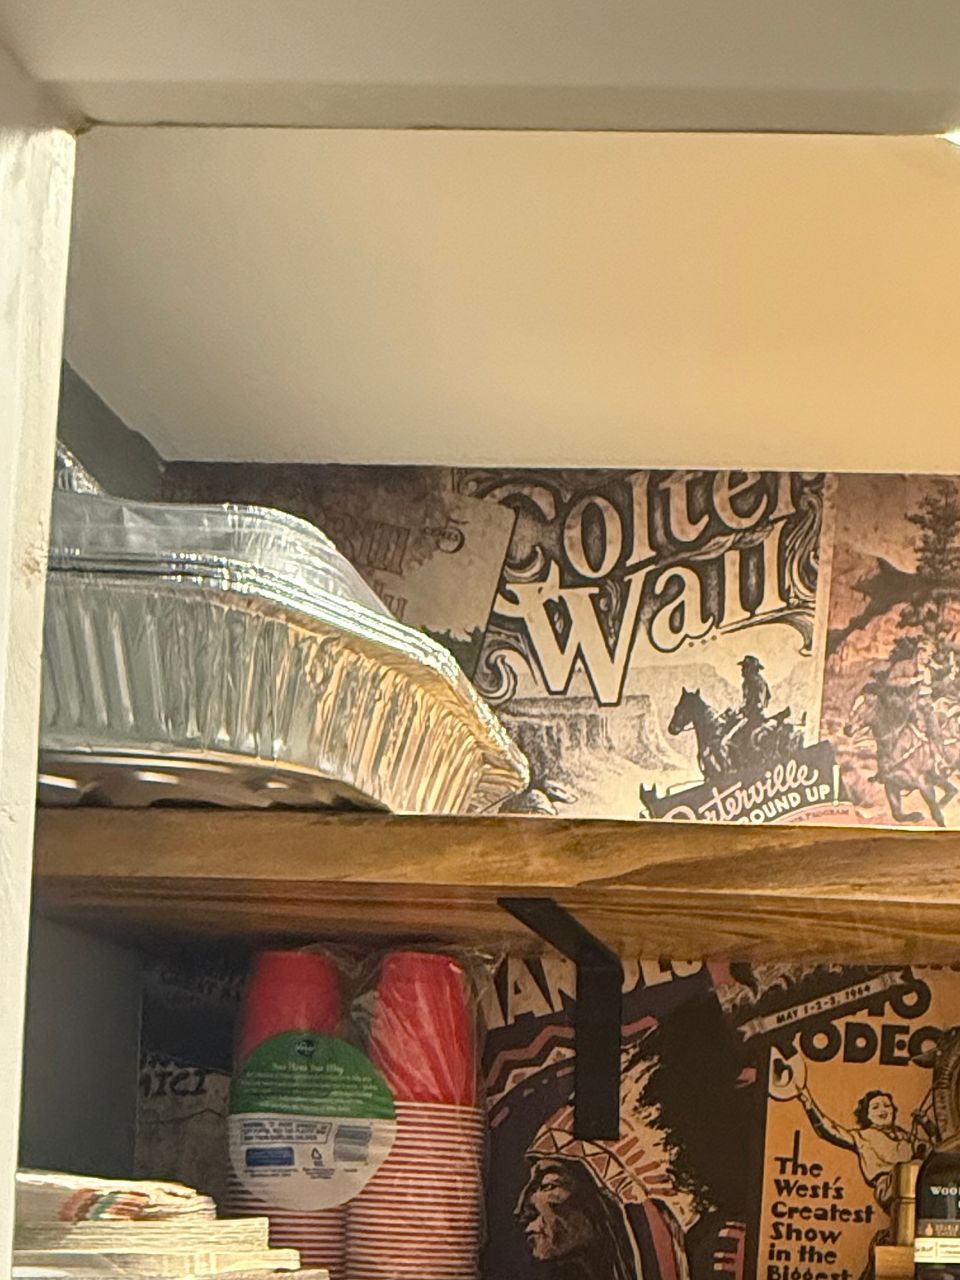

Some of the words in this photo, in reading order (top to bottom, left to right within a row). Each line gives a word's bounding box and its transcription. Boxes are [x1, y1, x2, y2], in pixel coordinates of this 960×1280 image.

[495, 520, 788, 707] Wall
[776, 1009, 799, 1024] MAY
[773, 1130, 824, 1177] The
[773, 1176, 845, 1200] West's
[770, 1222, 842, 1247] Show
[769, 1242, 791, 1263] in
[796, 1242, 838, 1265] the
